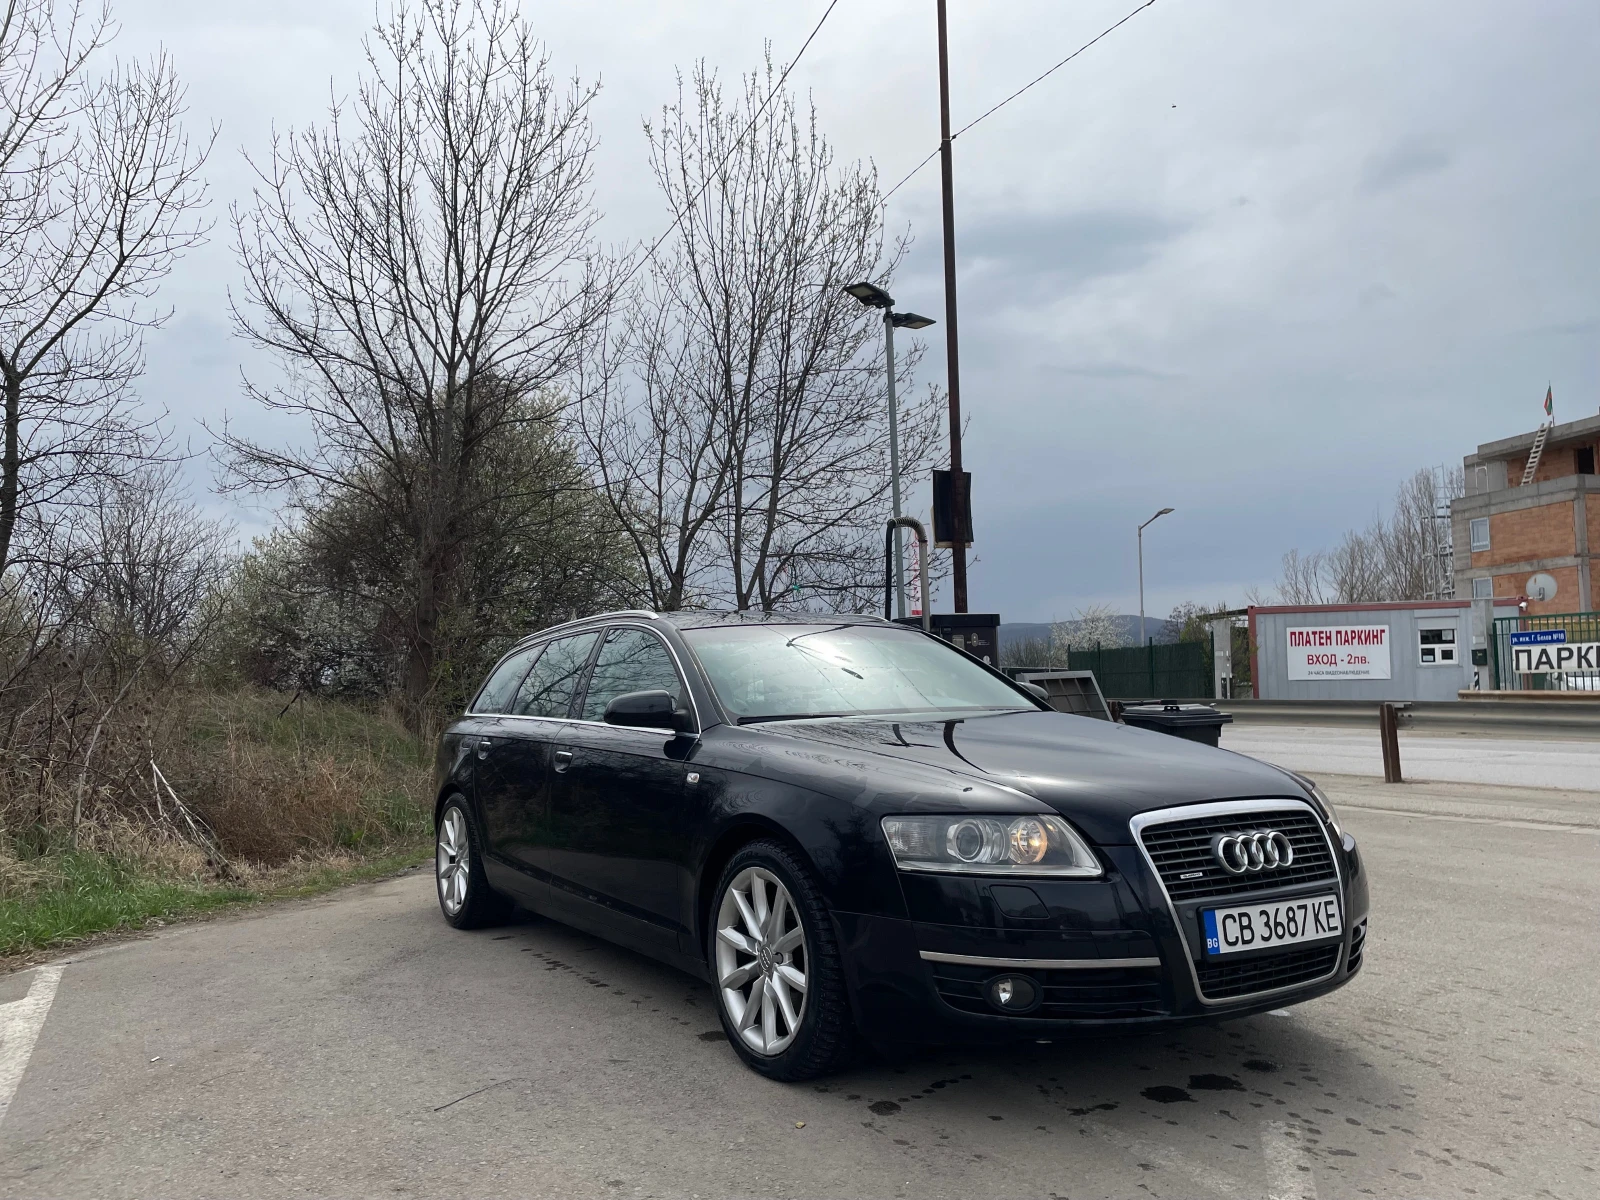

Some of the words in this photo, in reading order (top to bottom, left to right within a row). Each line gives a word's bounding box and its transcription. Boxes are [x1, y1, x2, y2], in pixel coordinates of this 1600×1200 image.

[1290, 631, 1332, 646] ПЛАТЕН
[1336, 629, 1385, 646] ПАРКИНГ
[1307, 654, 1338, 667] ВХОД
[1347, 653, 1370, 665] 2лв.
[1515, 645, 1600, 671] ПАРК
[1222, 912, 1255, 946] CB
[1259, 904, 1308, 942] 3687
[1312, 899, 1339, 934] KE
[1207, 938, 1218, 948] BG
